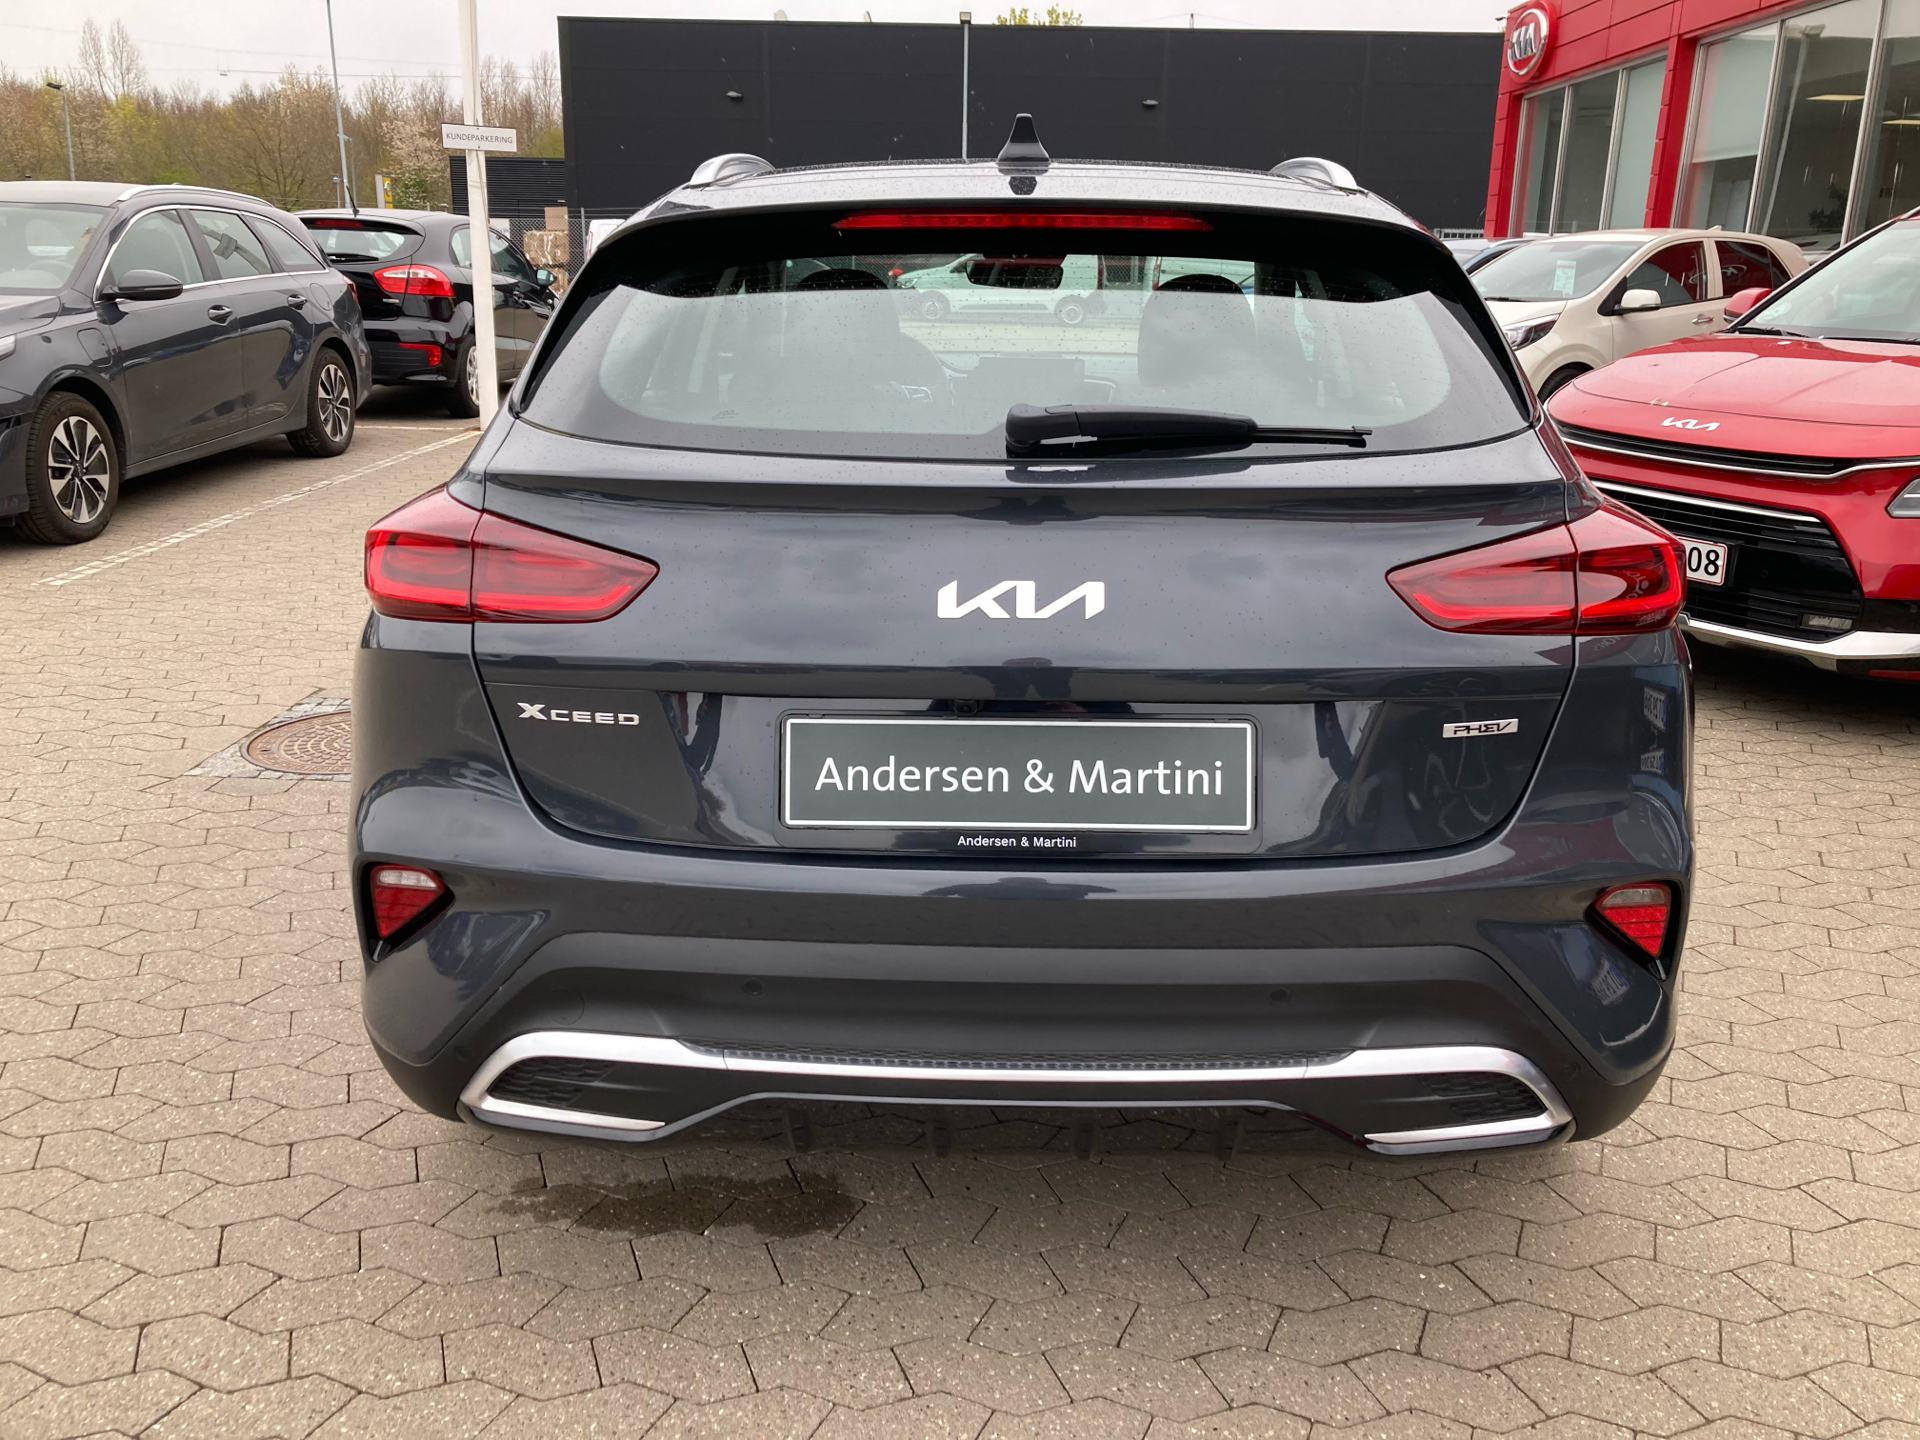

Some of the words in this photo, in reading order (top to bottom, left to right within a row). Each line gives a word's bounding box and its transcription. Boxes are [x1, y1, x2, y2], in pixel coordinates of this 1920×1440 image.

[446, 132, 513, 144] KUNDEPARKERING
[937, 580, 1105, 620] KIA
[517, 702, 640, 725] XCEED
[1453, 721, 1512, 735] PHEV
[814, 755, 1009, 792] Andersen
[1023, 758, 1055, 794] &
[1069, 760, 1222, 795] Martini
[957, 835, 1017, 847] Andersen
[1021, 836, 1029, 848] &
[1033, 836, 1077, 848] Martini
